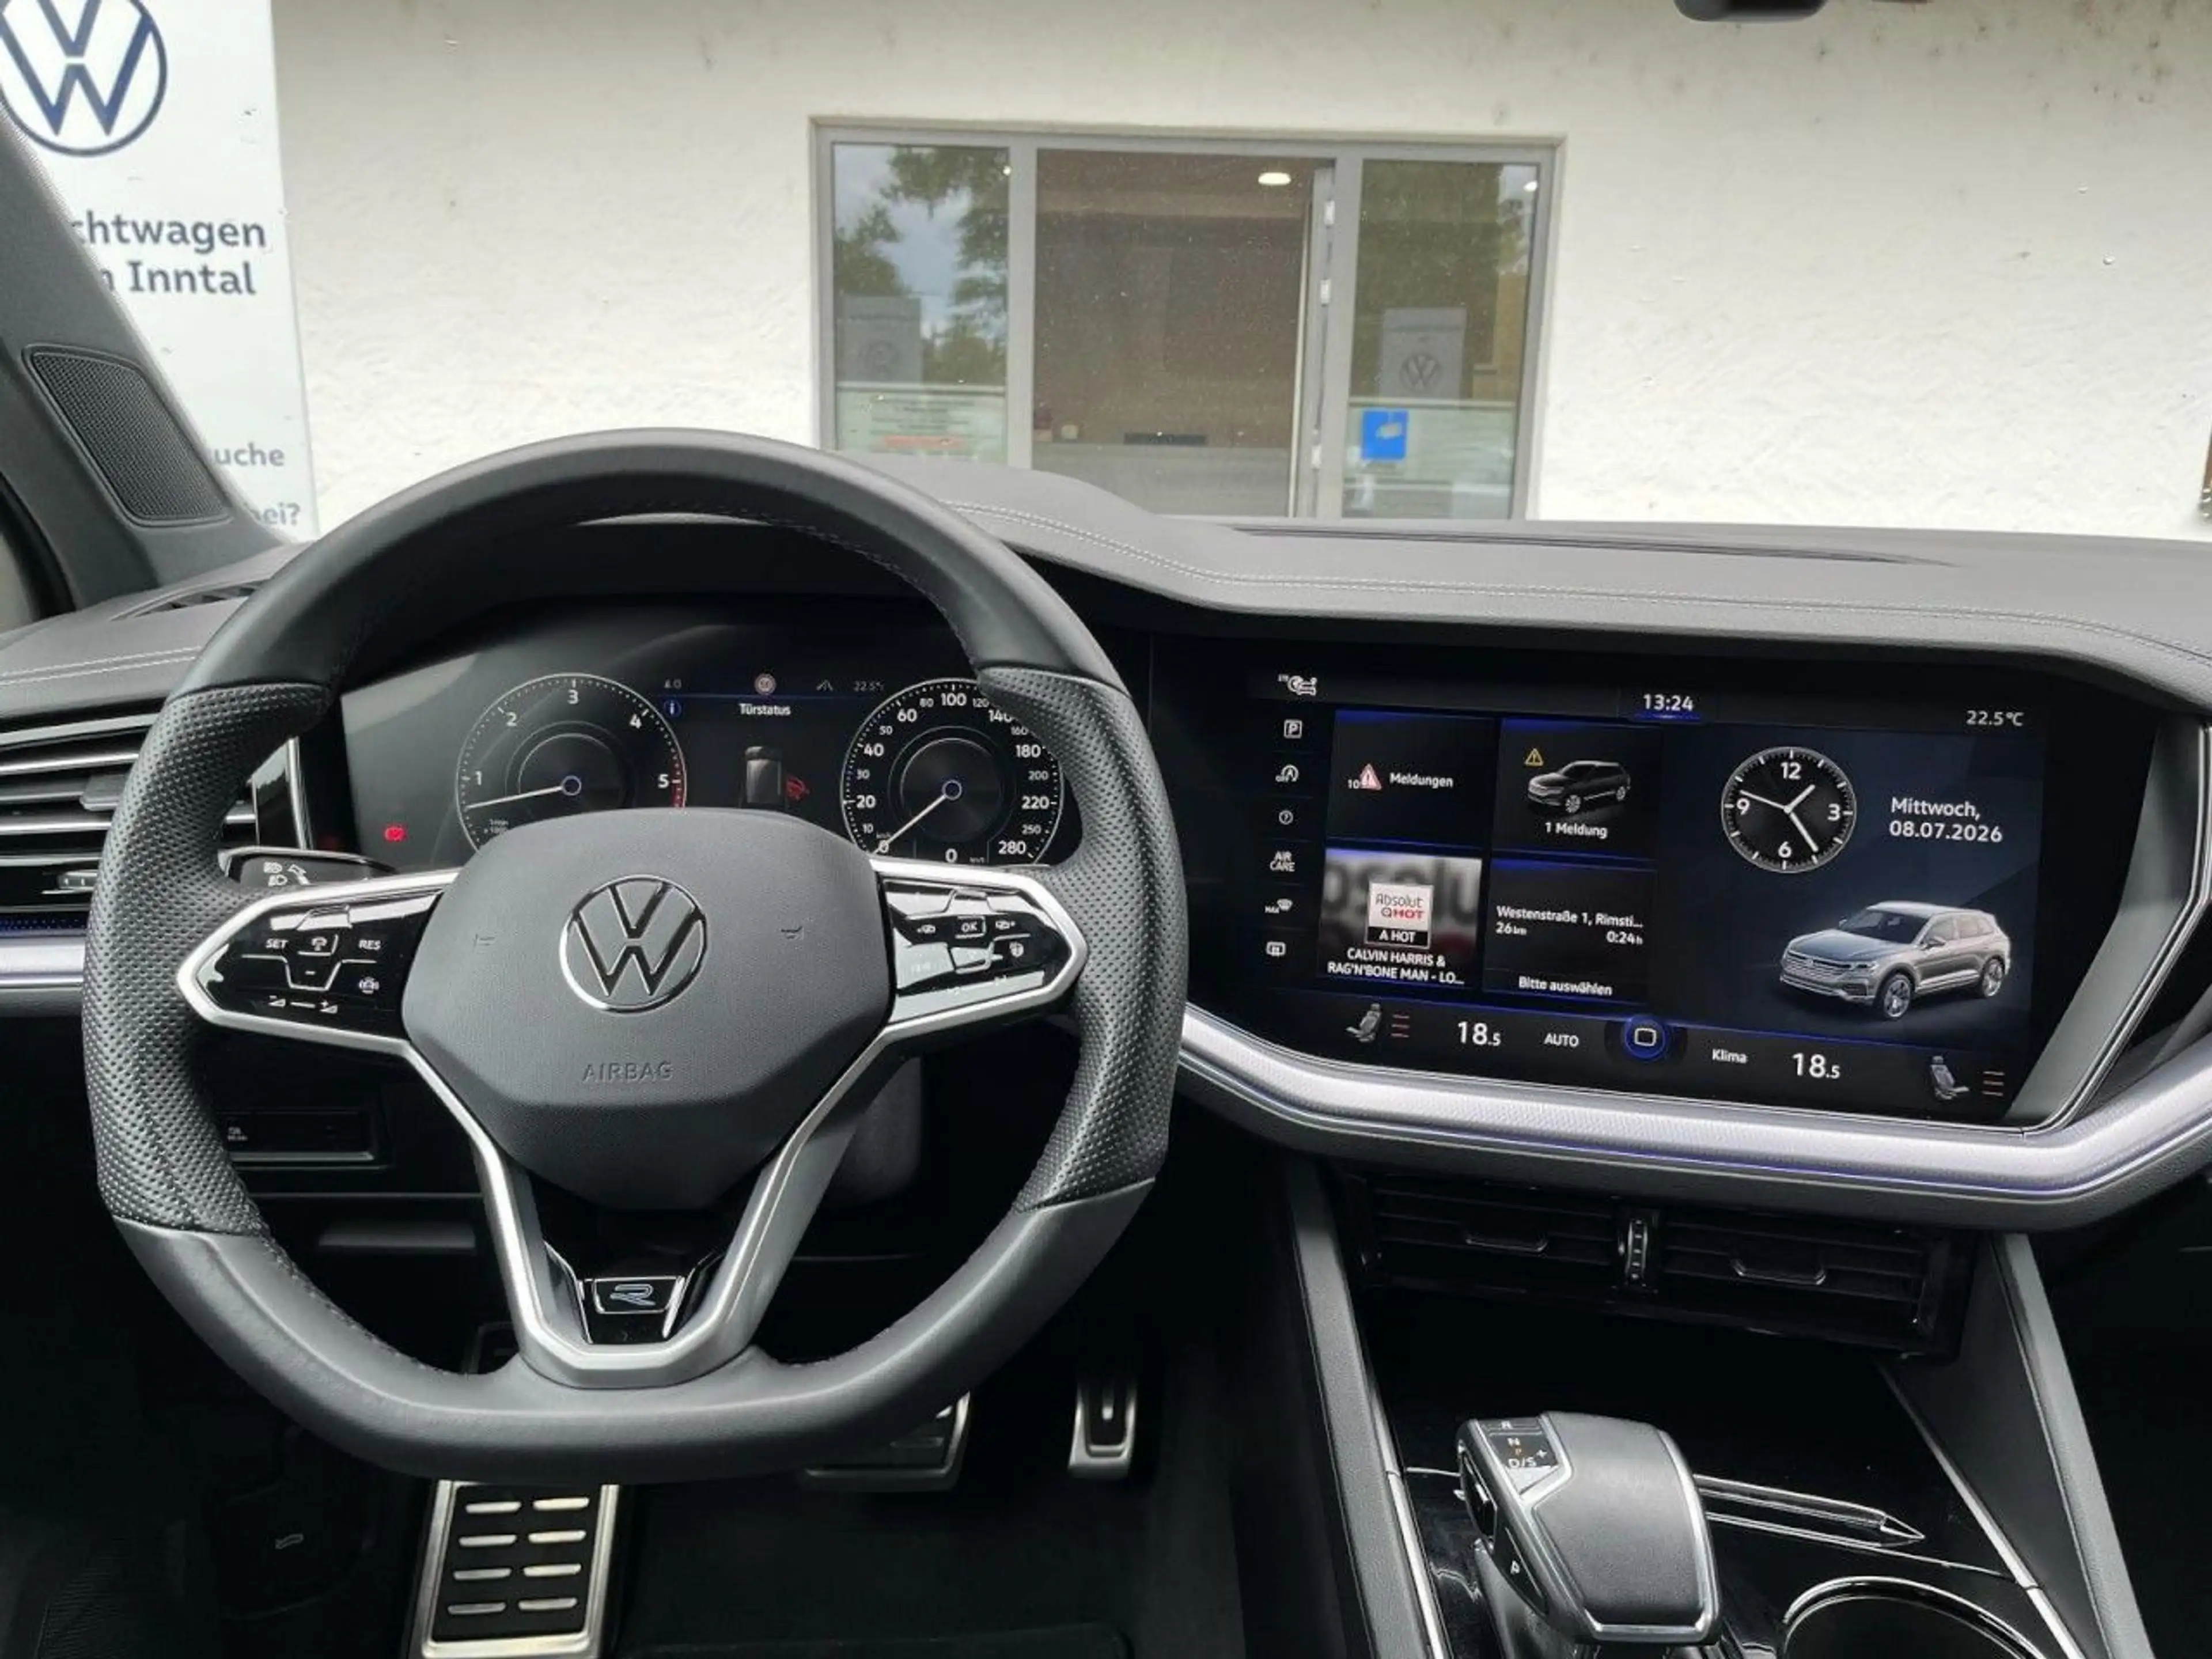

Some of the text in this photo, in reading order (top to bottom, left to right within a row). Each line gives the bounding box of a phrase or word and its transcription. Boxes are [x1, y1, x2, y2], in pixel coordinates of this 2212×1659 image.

[127, 261, 256, 296] Inntal
[567, 689, 579, 704] 3
[941, 692, 967, 706] 100
[1643, 693, 1695, 711] 13:24
[739, 703, 791, 716] Türstatus
[897, 709, 917, 722] 60
[506, 712, 517, 726] 2
[629, 714, 642, 729] 4
[1966, 709, 2025, 727] 22.5°C
[880, 725, 893, 735] 50
[864, 743, 884, 756] 40
[1016, 744, 1041, 758] 180
[475, 771, 482, 785] 1
[857, 769, 870, 779] 30
[1028, 770, 1049, 781] 200
[1780, 762, 1802, 781] 12
[657, 774, 669, 789] 5
[1347, 771, 1454, 789] 10 Meldungen
[857, 794, 876, 809] 20
[1021, 795, 1050, 809] 220
[1736, 798, 1751, 816] 9
[1891, 796, 1982, 821] Mittwoch,
[1827, 803, 1841, 821] 3
[1021, 824, 1042, 835] 250
[1545, 822, 1608, 839] 1 Meldung
[1888, 819, 2003, 843] 08.07.2026
[998, 840, 1027, 855] 280
[1777, 840, 1792, 859] 6
[945, 848, 958, 863] 0
[1270, 861, 1296, 872] CARE
[1497, 905, 1578, 923] Westenstraße
[1581, 912, 1593, 926] 1,
[961, 921, 978, 932] OK
[266, 938, 288, 949] SET
[1379, 929, 1416, 943] A HOT
[358, 939, 381, 950] RES
[1347, 947, 1446, 968] CALVIN HARRIS &
[1400, 968, 1429, 982] MAN
[1518, 976, 1613, 996] Bitte auswählen
[1458, 1021, 1502, 1047] 18.5
[1544, 1033, 1580, 1048] AUTO
[1712, 1048, 1748, 1065] Klima
[582, 1060, 673, 1083] AIRBAG
[1791, 1052, 1840, 1079] 18.5
